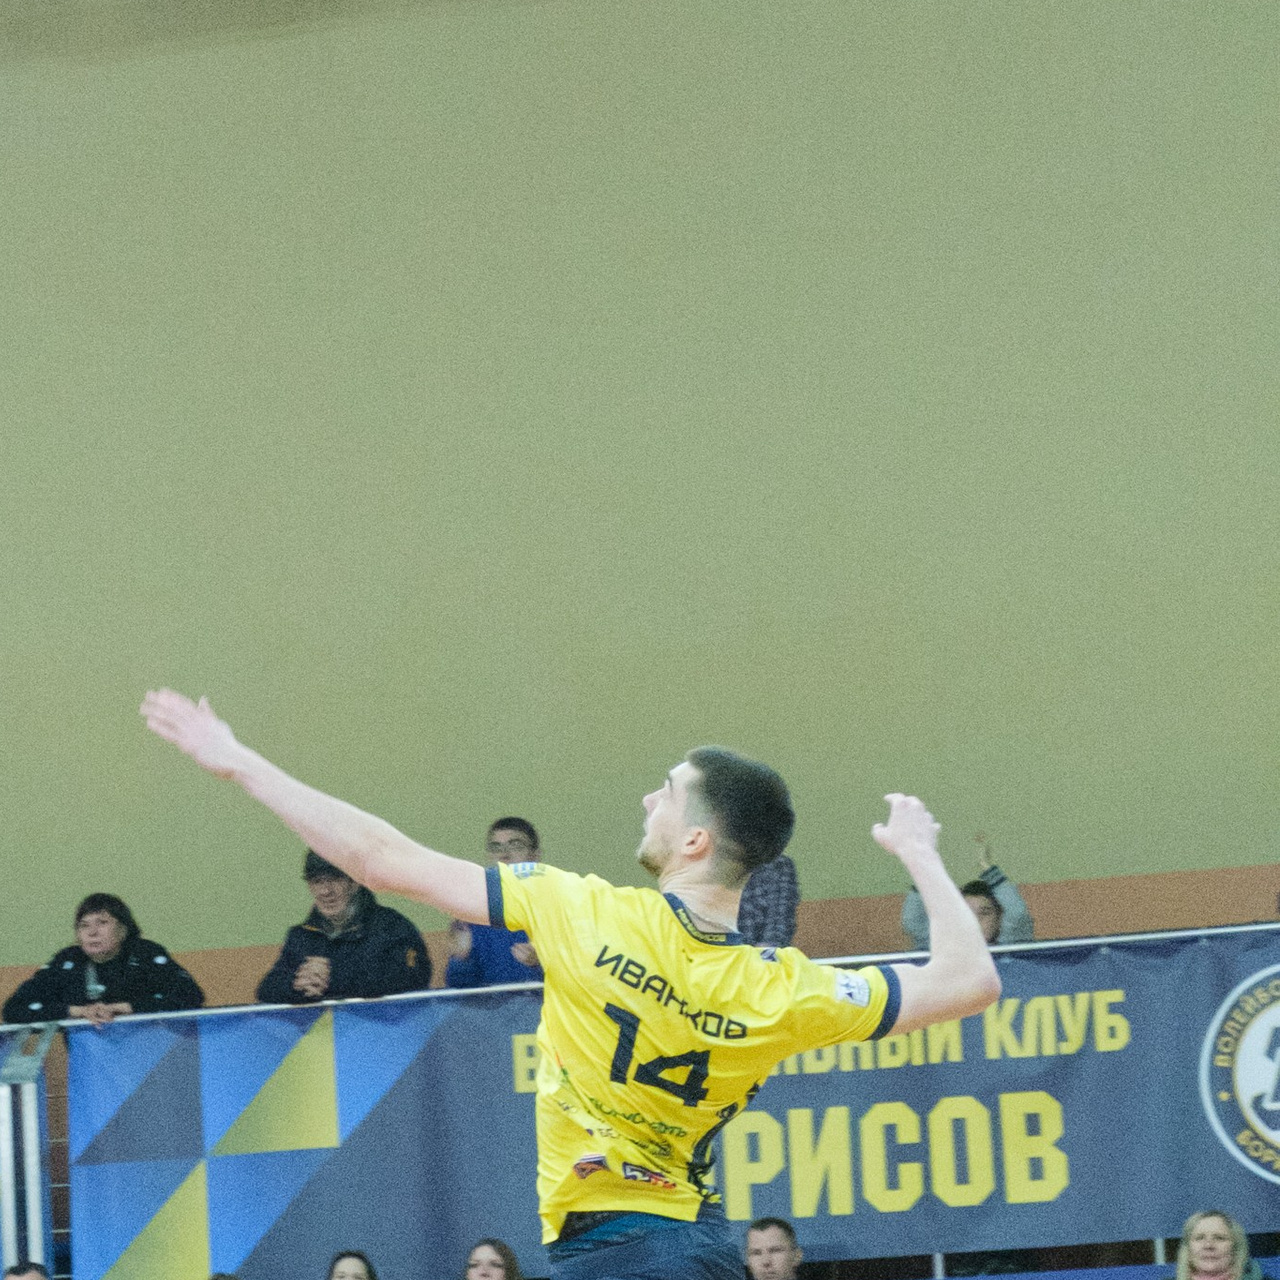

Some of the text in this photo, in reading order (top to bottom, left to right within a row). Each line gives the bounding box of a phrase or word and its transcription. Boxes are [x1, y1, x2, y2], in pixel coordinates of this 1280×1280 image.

[594, 945, 748, 1040] ИВАНКОВ
[984, 990, 1131, 1058] КЛУБ
[603, 1002, 711, 1108] 14
[725, 1091, 1071, 1222] РИСОВ
